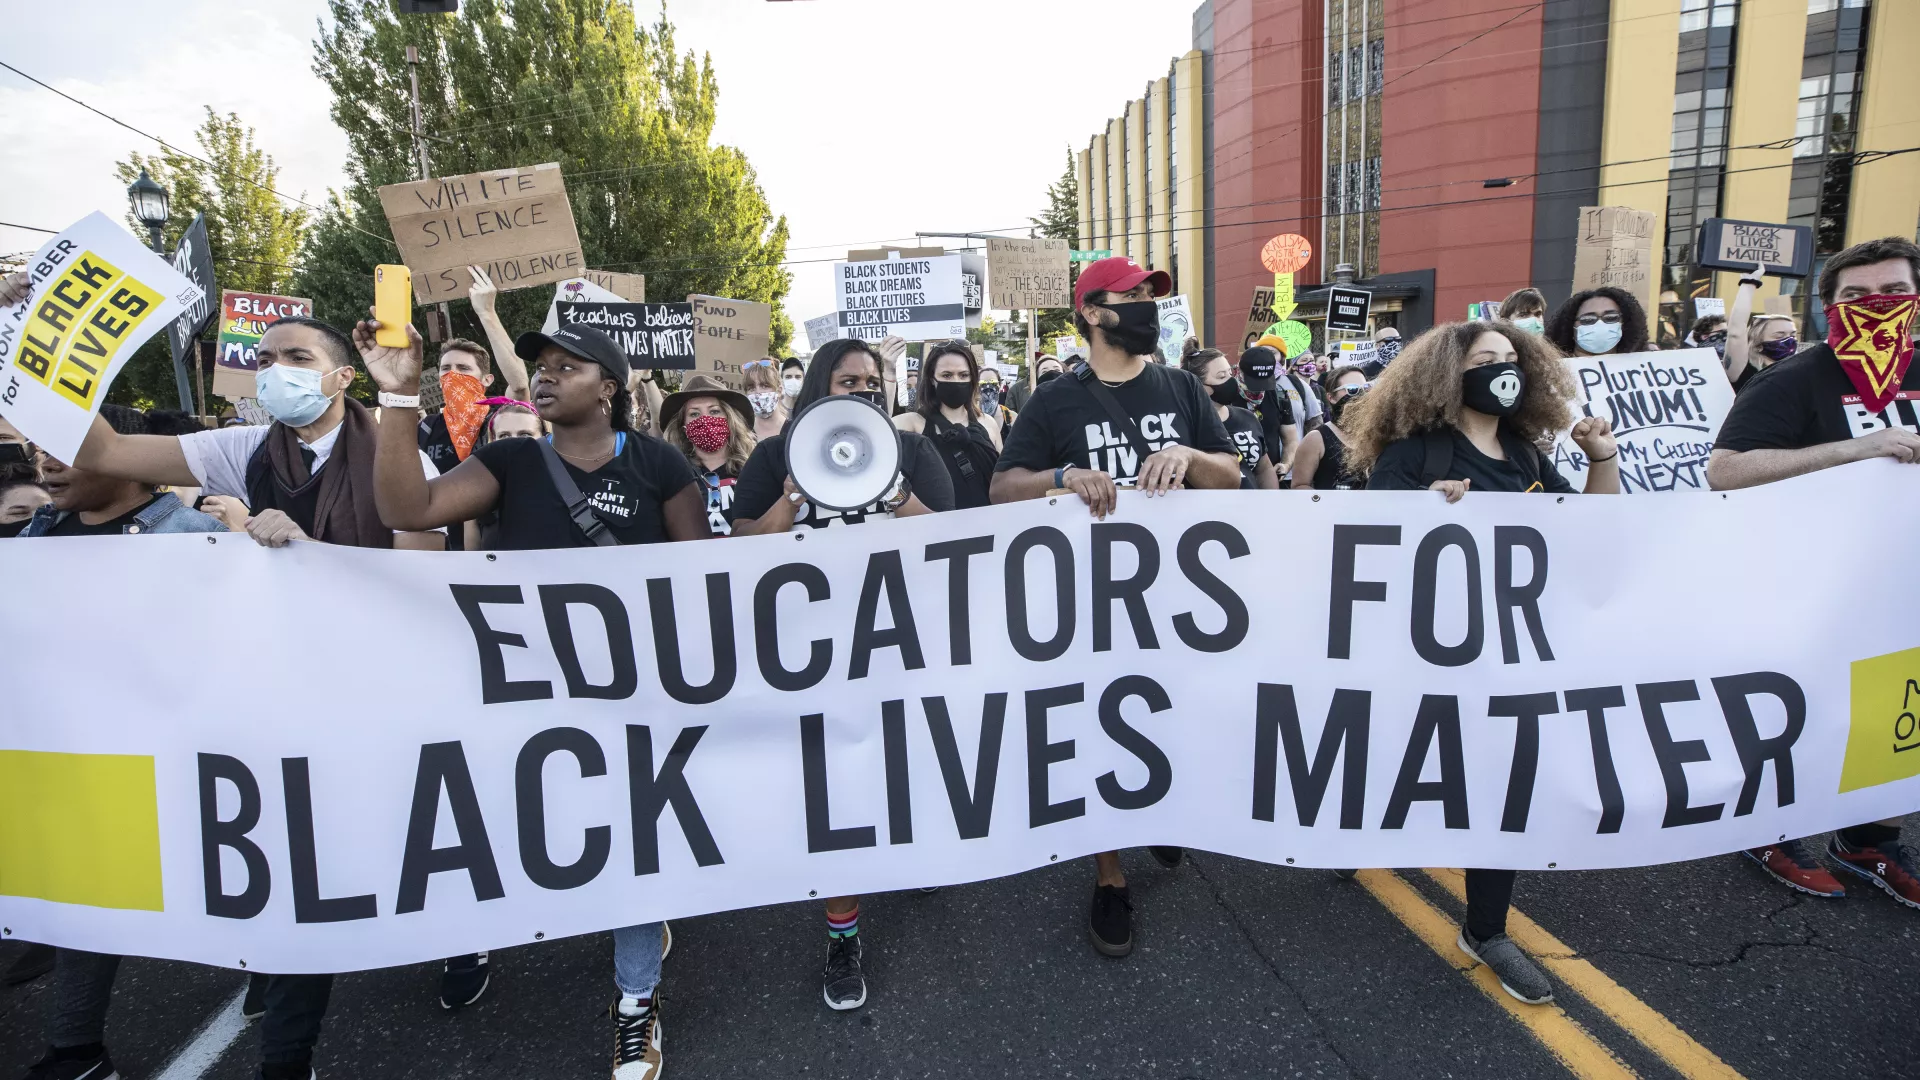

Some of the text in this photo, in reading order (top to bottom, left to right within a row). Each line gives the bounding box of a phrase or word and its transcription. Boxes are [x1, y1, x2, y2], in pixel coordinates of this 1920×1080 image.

[415, 173, 536, 211] WHITE
[422, 202, 549, 248] SILENCE
[1585, 208, 1605, 241] IT
[1733, 225, 1783, 240] BLACK
[1004, 240, 1019, 252] the
[1264, 234, 1305, 255] RACISM
[1741, 237, 1774, 250] LIVES
[1275, 248, 1295, 258] IS THE
[1726, 247, 1783, 264] MATTER
[844, 260, 931, 279] BLACK STUDENTS
[1263, 255, 1303, 273] PANDEMIC
[424, 268, 458, 295] IS
[845, 277, 922, 294] BLACK DREAMS
[1010, 276, 1033, 291] THE
[1034, 276, 1062, 291] SILENCE
[846, 292, 926, 310] BLACK FUTURES
[992, 293, 1019, 309] OUR
[1024, 292, 1059, 306] FRIENDS
[1276, 277, 1290, 313] #BLM
[1335, 295, 1365, 305] BLACK LIVES
[233, 296, 305, 318] BLACK
[1156, 298, 1182, 311] #BLM
[1297, 308, 1321, 317] SANDY
[1340, 306, 1359, 314] MATTER
[18, 257, 113, 379] BLACK
[562, 304, 694, 328] teachers believe
[847, 308, 911, 325] BLACK LIVES
[693, 317, 746, 341] PEOPLE
[848, 325, 888, 340] MATTER
[58, 287, 149, 399] LIVES
[651, 328, 695, 359] MATTER
[1356, 341, 1375, 351] BLACK
[1578, 360, 1708, 402] Pluribus
[2, 375, 20, 406] for
[1582, 387, 1708, 432] UNUM!
[607, 482, 612, 491] I
[594, 491, 625, 504] CAN'T
[449, 521, 1556, 705] EDUCATORS FOR
[197, 670, 1807, 925] BLACK LIVES MATTER
